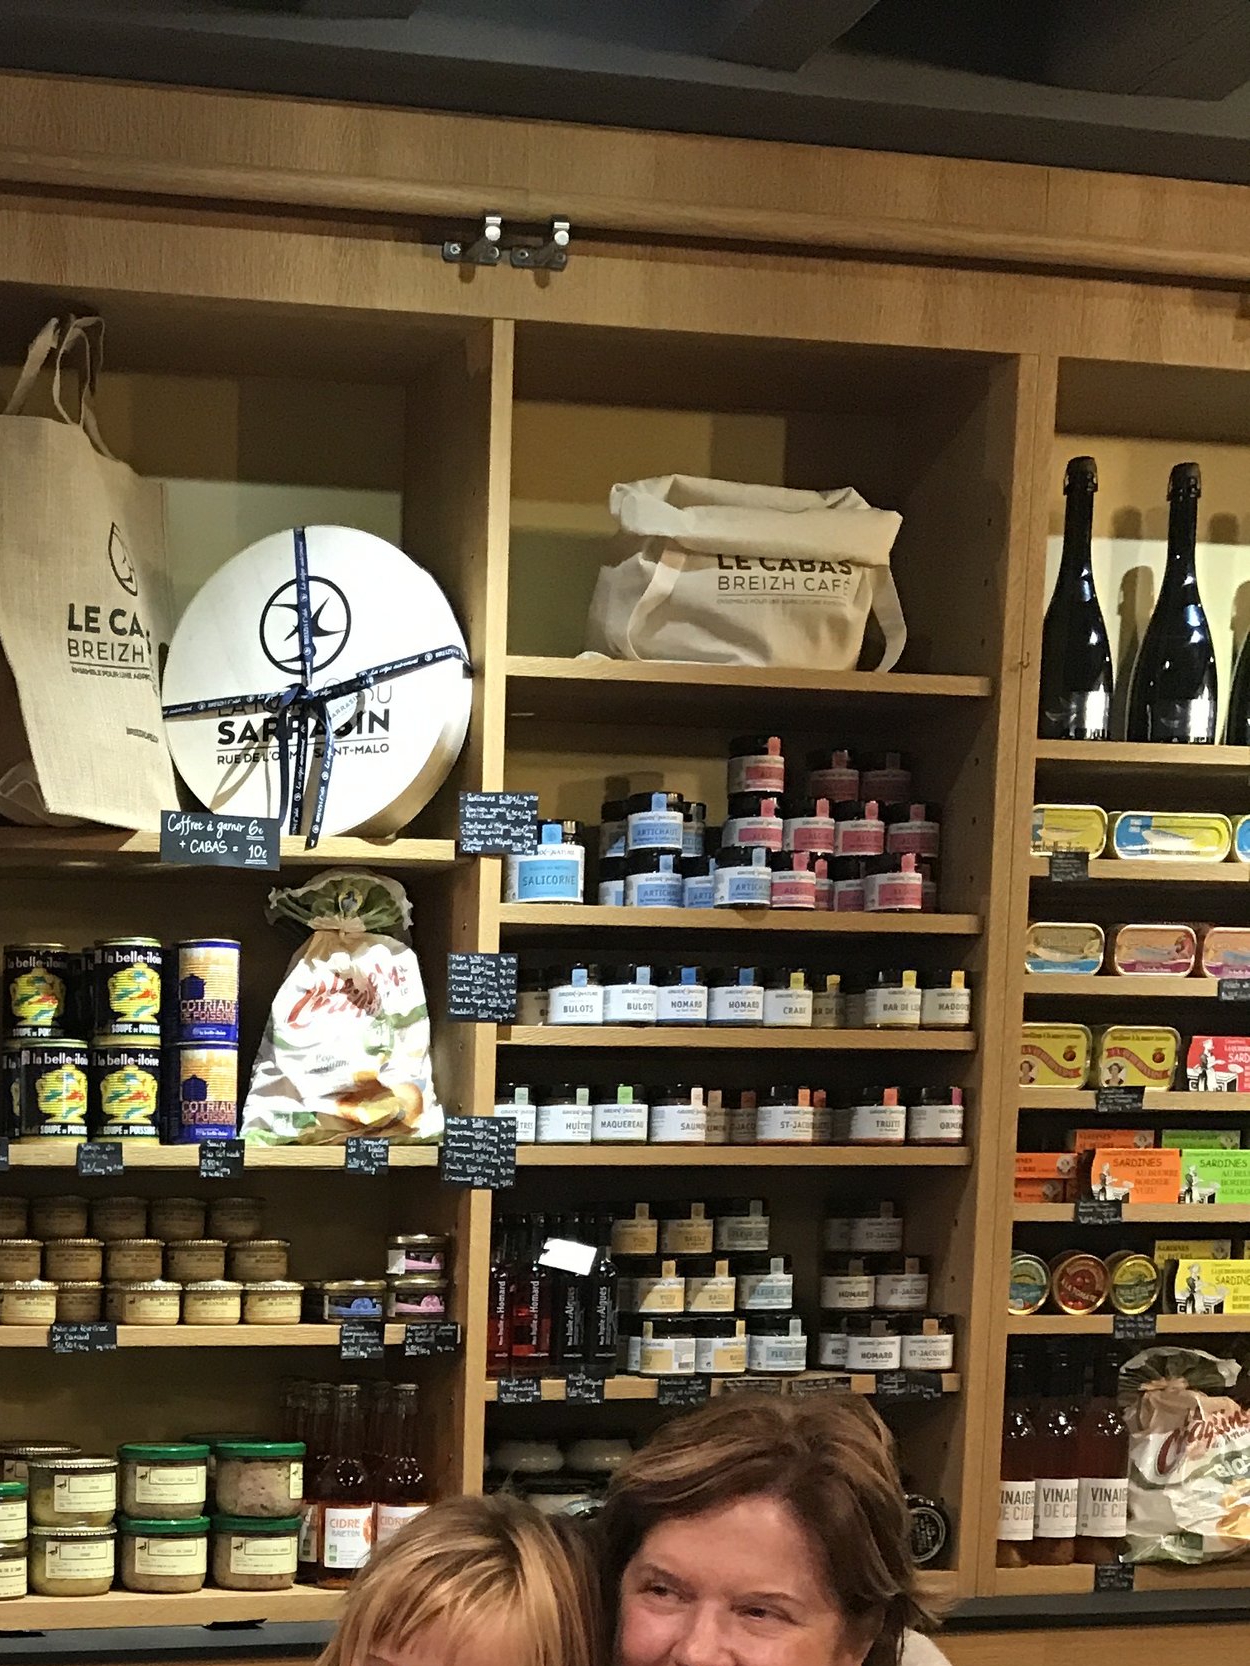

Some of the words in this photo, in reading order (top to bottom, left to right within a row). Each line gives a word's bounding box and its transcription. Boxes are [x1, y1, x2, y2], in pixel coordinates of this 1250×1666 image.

[717, 554, 752, 570] LE
[759, 556, 852, 575] CABAS
[718, 576, 795, 590] BREIZH
[68, 603, 101, 634] LE
[68, 638, 144, 663] BREIZH
[217, 750, 242, 765] RUE
[244, 752, 260, 764] DE
[314, 744, 390, 758] SANT-MALO
[168, 814, 205, 836] Coffret
[207, 821, 214, 832] à
[216, 821, 246, 839] garnir
[190, 840, 228, 854] CABAS
[522, 874, 576, 886] SALICORNE
[104, 952, 114, 964] la
[180, 1000, 236, 1012] COTRIADE
[563, 1005, 594, 1013] BULOTS
[627, 1002, 654, 1010] BULOTS
[671, 1000, 702, 1009] HOMARD
[112, 1024, 132, 1034] SOUPE
[32, 1053, 42, 1065] la
[107, 1052, 159, 1067] belle-iloise
[182, 1101, 236, 1112] COTRIADE
[40, 1125, 62, 1134] SOUPE
[104, 1126, 125, 1135] SOUPE
[600, 1120, 644, 1129] MAQUEREAU
[1113, 1158, 1162, 1167] SARDINES
[1200, 1159, 1248, 1168] SARDINES
[496, 1281, 506, 1314] Homard
[530, 1281, 539, 1314] Homard
[1044, 1504, 1059, 1517] DE
[1092, 1503, 1108, 1517] DE
[330, 1519, 360, 1529] CIDRE
